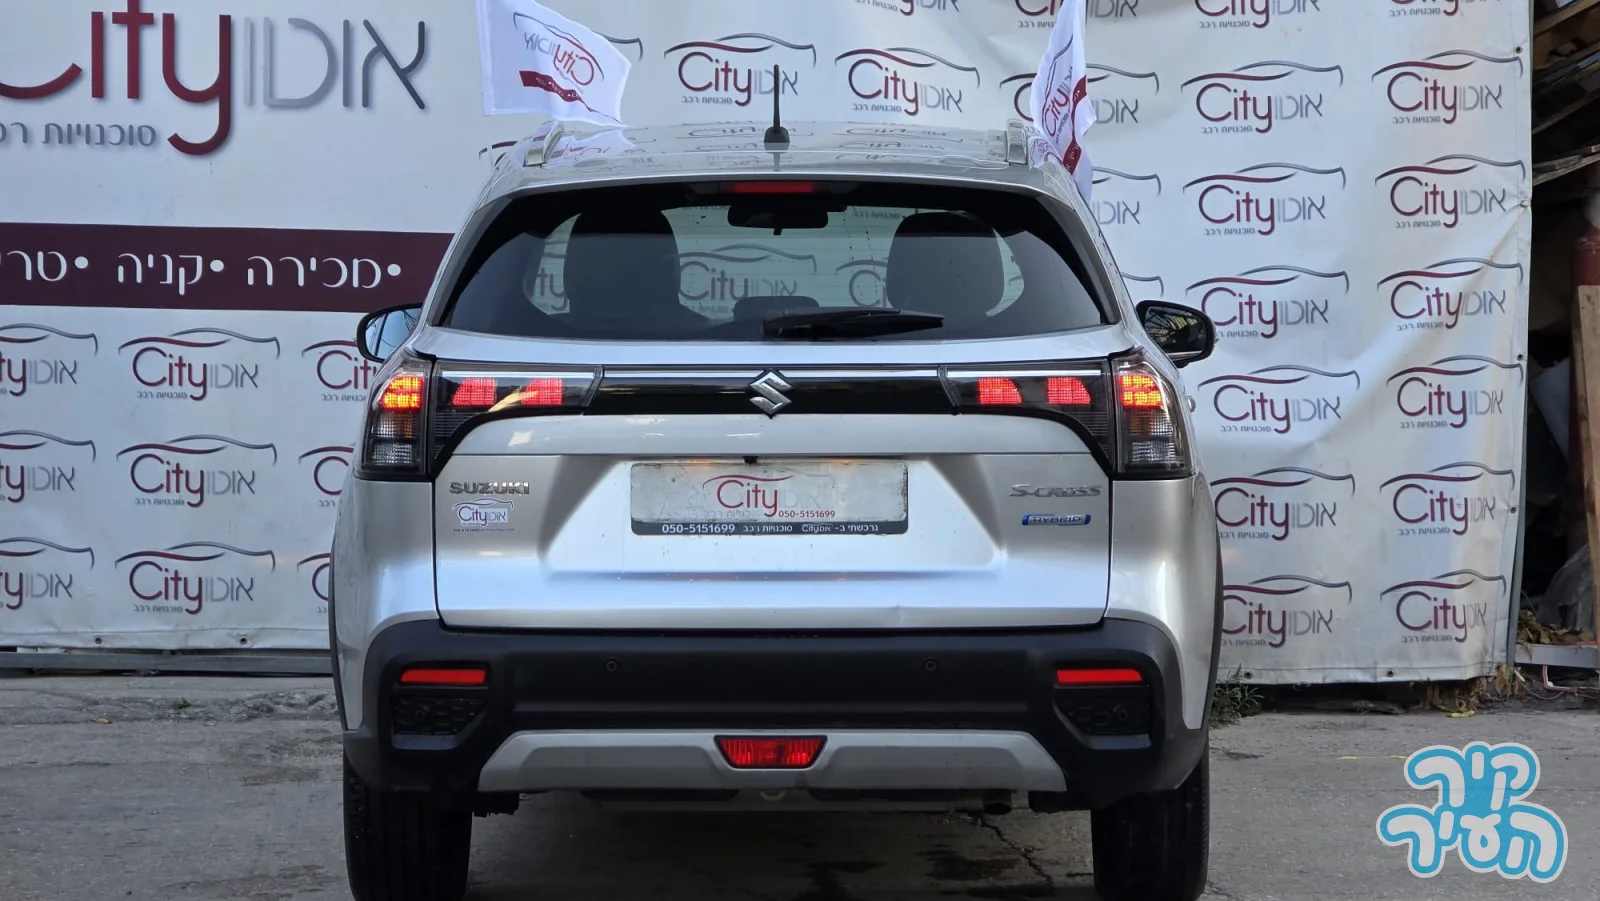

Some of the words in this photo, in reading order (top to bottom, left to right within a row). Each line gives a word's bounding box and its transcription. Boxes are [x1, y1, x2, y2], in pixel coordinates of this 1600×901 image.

[0, 0, 231, 155] ity
[678, 52, 751, 106] City
[848, 59, 920, 115] City
[1387, 71, 1457, 124] City
[1196, 83, 1272, 133] City
[42, 122, 157, 147] סוכנויות
[1199, 185, 1275, 235] City
[1390, 176, 1459, 228] City
[117, 253, 203, 295] קניה
[247, 255, 382, 289] מכירה
[1201, 287, 1278, 338] City
[1391, 281, 1463, 329] City
[133, 347, 207, 402] City
[317, 350, 376, 389] Cit
[1214, 384, 1290, 434] City
[1397, 377, 1467, 428] City
[131, 453, 205, 508] City
[449, 482, 530, 495] SUZUKI
[717, 480, 778, 517] City
[459, 506, 487, 526] City
[662, 524, 736, 534] 050-5151699
[743, 525, 760, 533] רכב
[779, 510, 836, 518] 050-5151699
[1215, 487, 1289, 541] City
[1393, 484, 1468, 535] City
[129, 561, 203, 615] City
[1396, 591, 1467, 643] City
